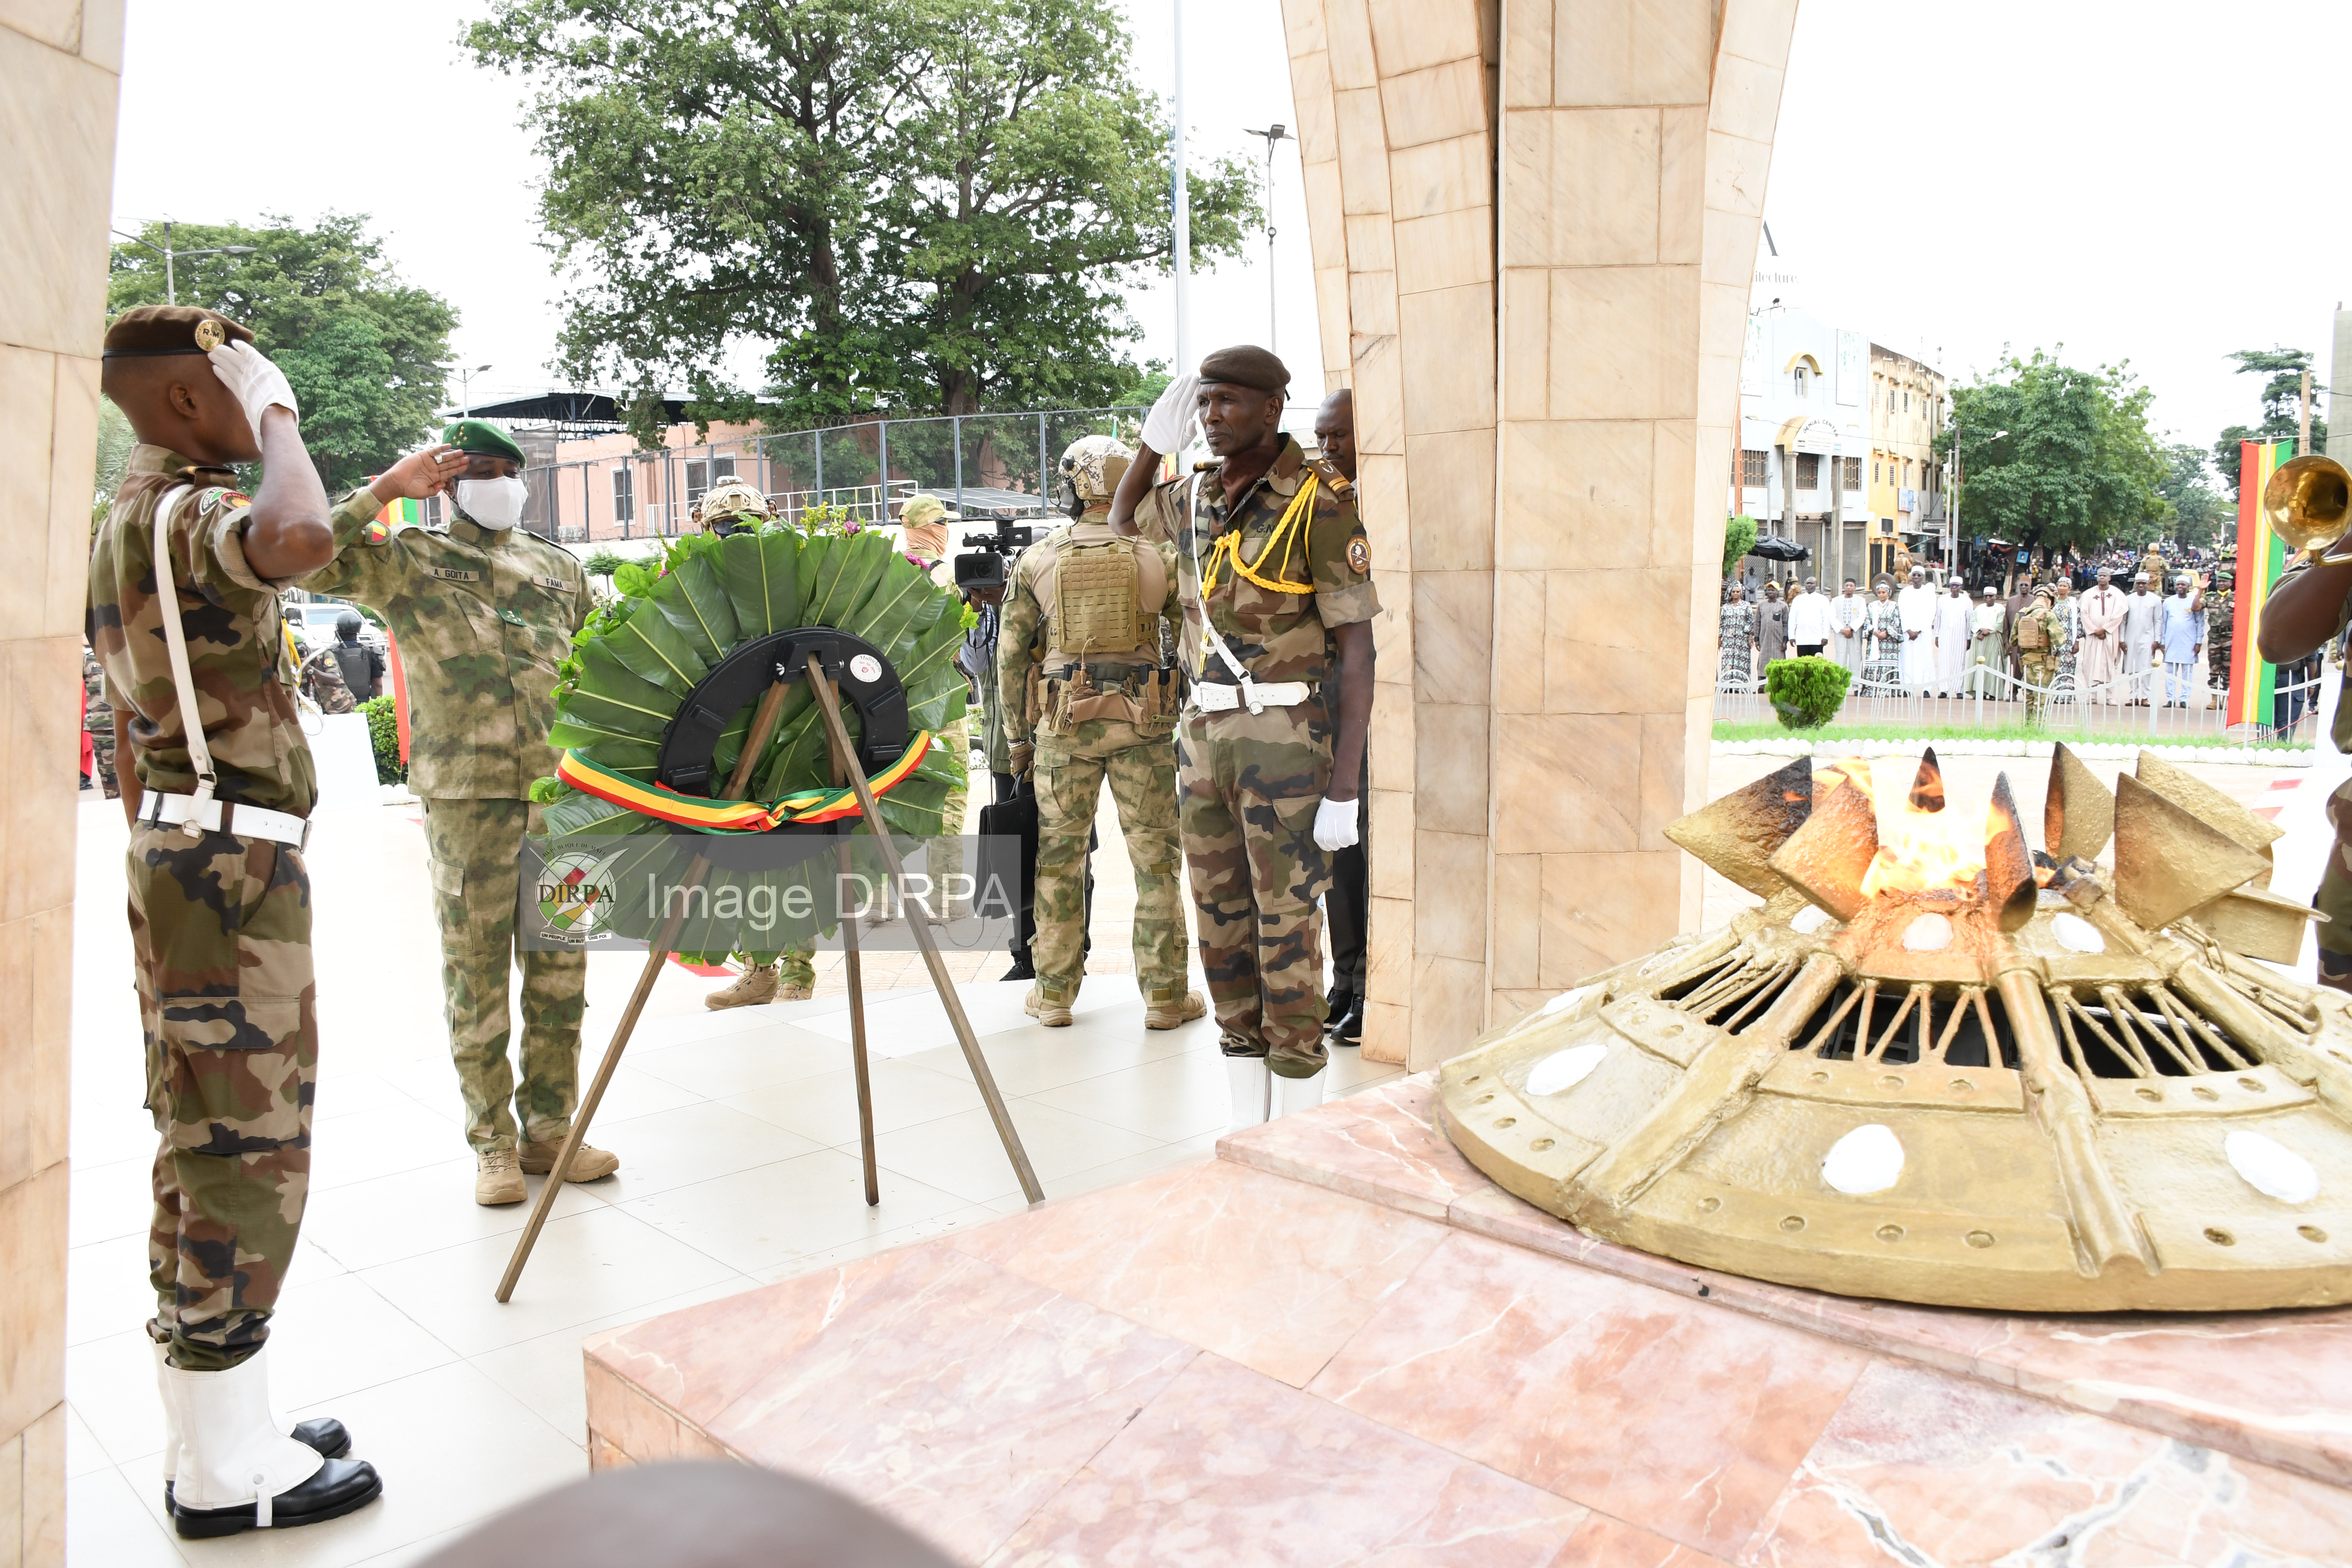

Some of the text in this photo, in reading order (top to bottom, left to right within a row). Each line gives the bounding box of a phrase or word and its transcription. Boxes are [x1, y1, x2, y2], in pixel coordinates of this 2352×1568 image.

[445, 569, 469, 580] GOITA
[545, 578, 564, 590] FAMA
[860, 656, 881, 672] Multichem
